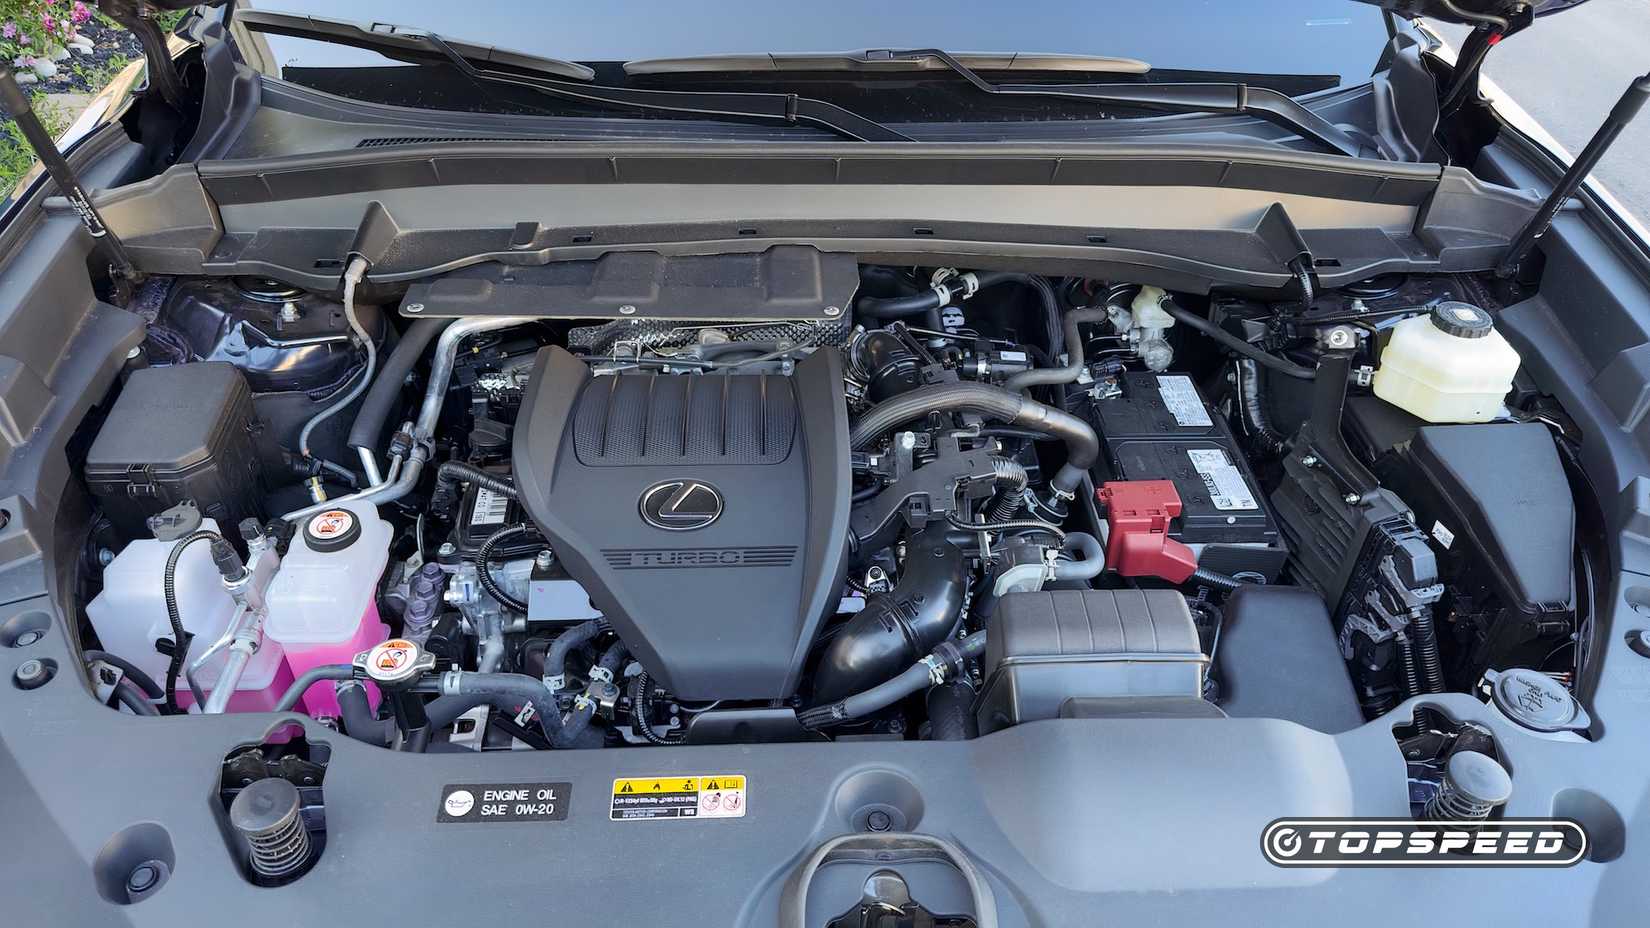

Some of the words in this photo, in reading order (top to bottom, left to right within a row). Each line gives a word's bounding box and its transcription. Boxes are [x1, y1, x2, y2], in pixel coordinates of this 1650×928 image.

[635, 551, 740, 565] TURBO
[483, 789, 530, 802] ENGINE
[536, 788, 557, 801] OIL
[480, 804, 509, 816] SAE
[515, 803, 555, 816] 0W-20
